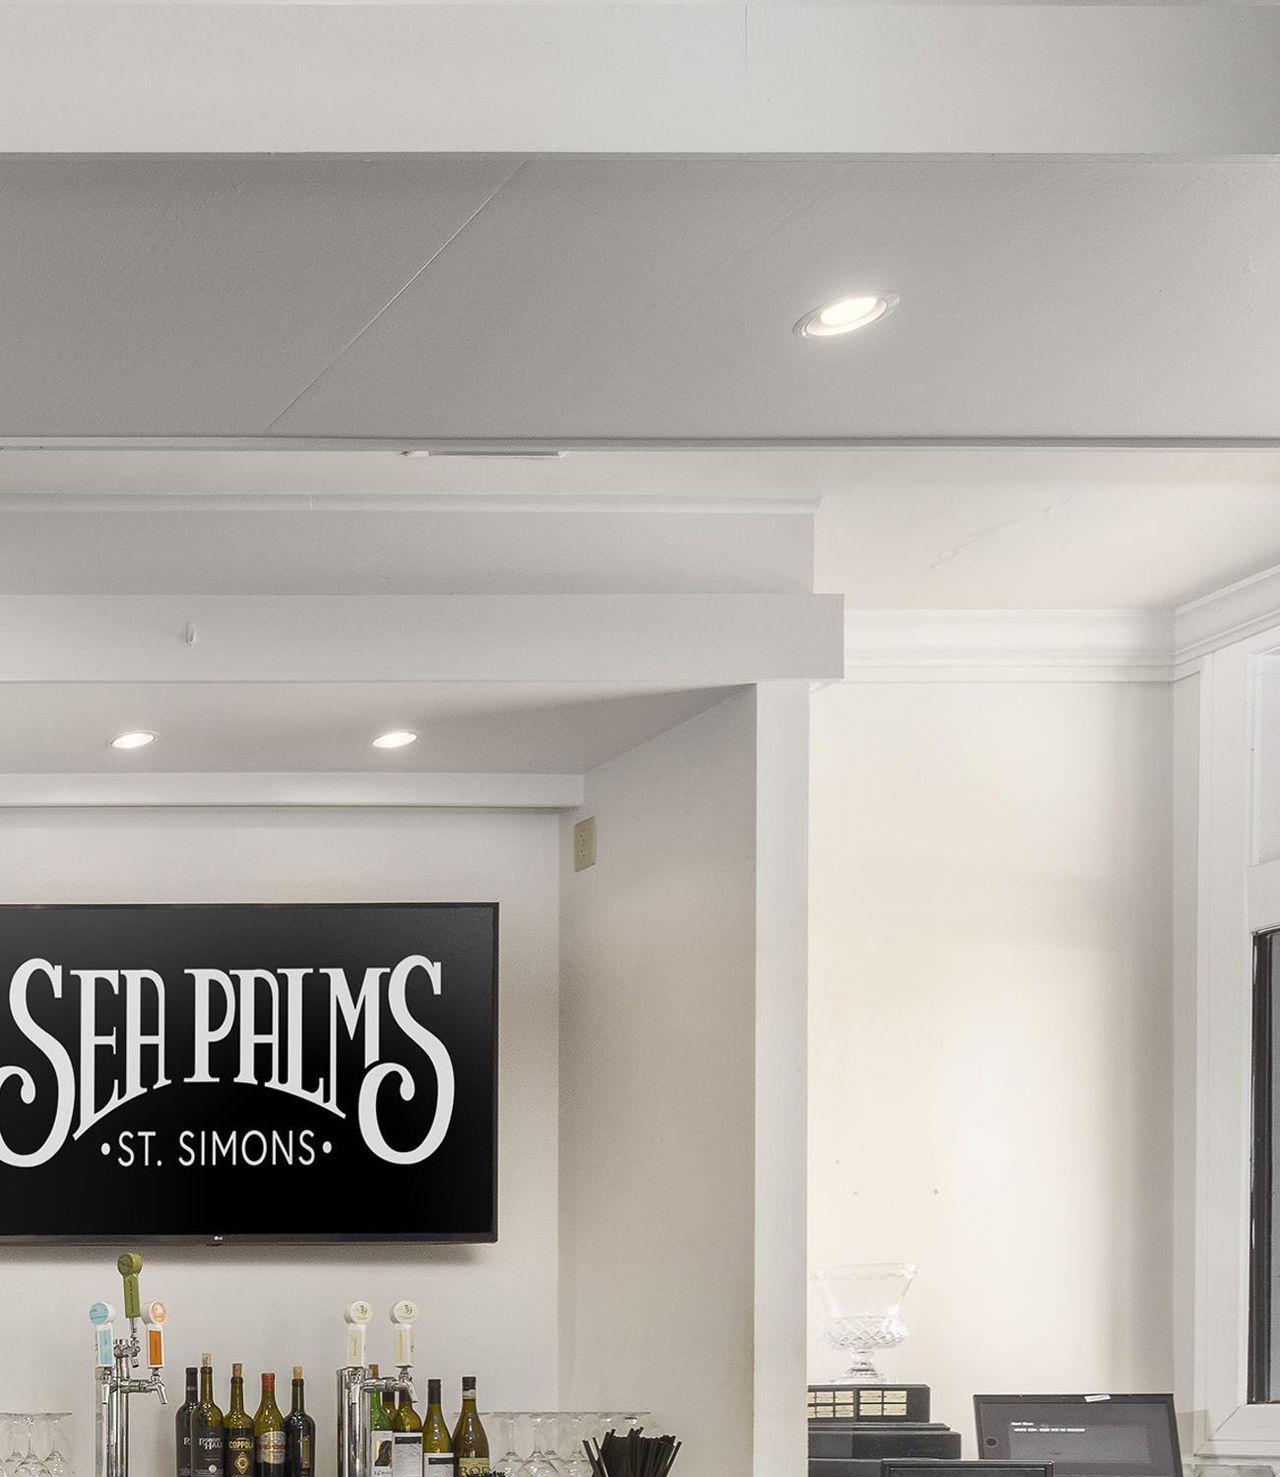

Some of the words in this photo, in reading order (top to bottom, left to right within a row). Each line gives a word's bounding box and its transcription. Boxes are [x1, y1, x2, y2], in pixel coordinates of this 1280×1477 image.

[184, 954, 455, 1165] PALMS
[117, 1131, 163, 1166] ST.
[178, 1129, 316, 1166] SIMONS
